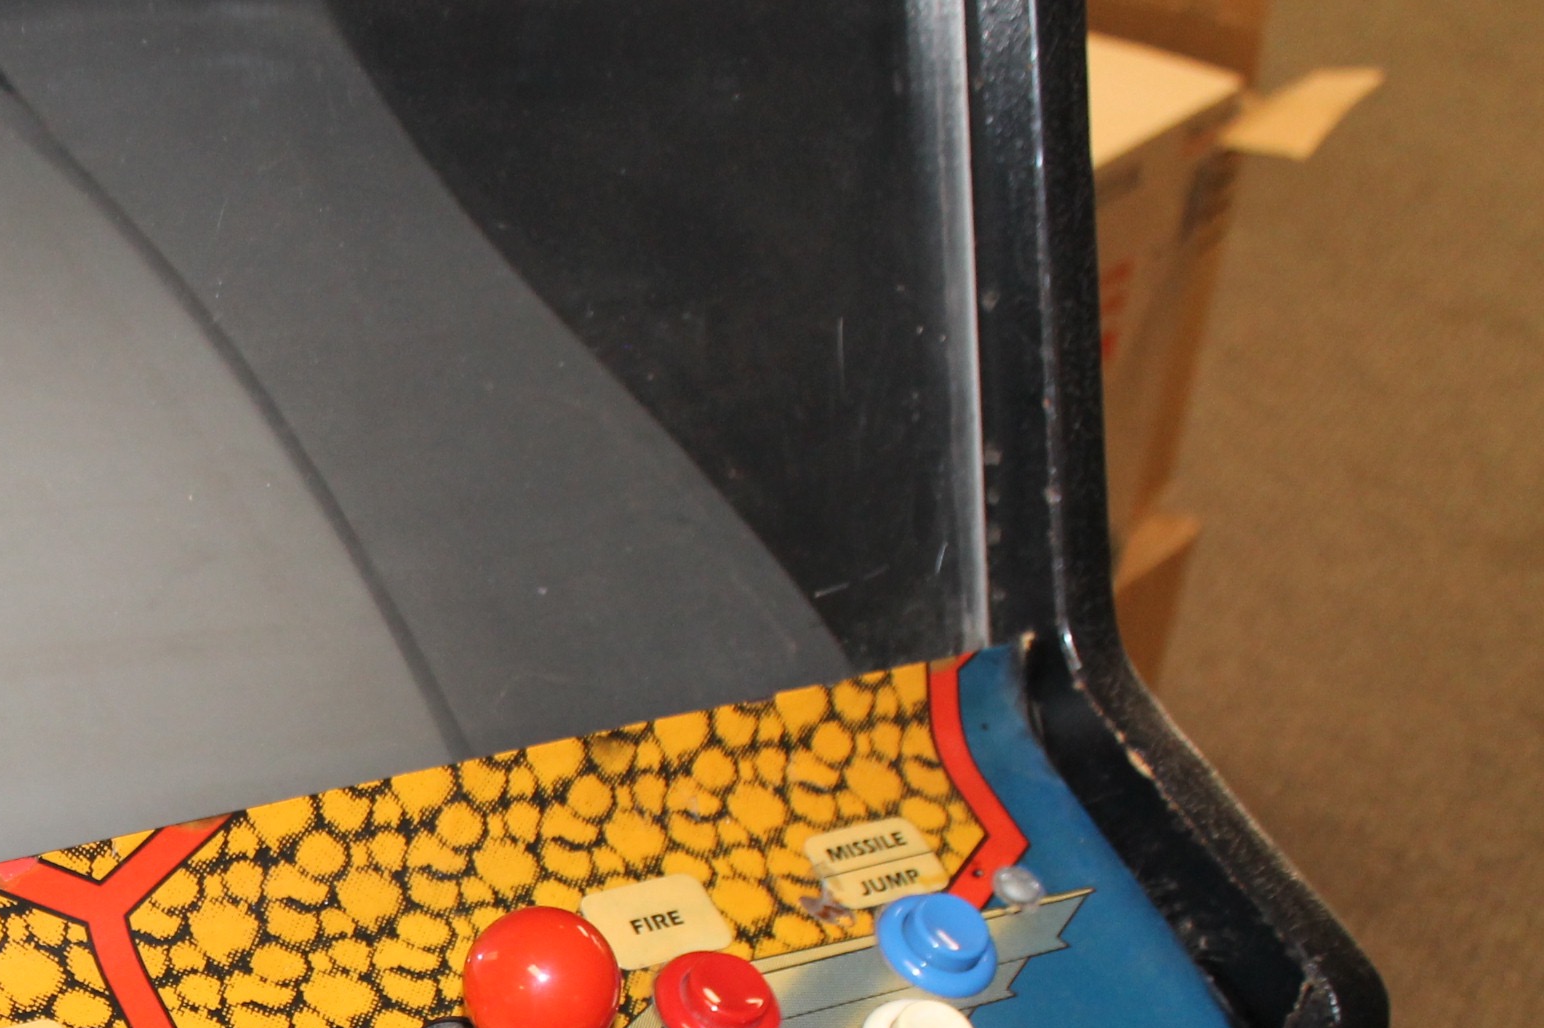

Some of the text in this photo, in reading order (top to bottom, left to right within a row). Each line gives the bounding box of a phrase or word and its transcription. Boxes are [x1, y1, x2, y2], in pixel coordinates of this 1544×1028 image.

[826, 832, 907, 862] MISSILE
[861, 869, 919, 896] JUMP
[630, 910, 684, 936] FIRE
